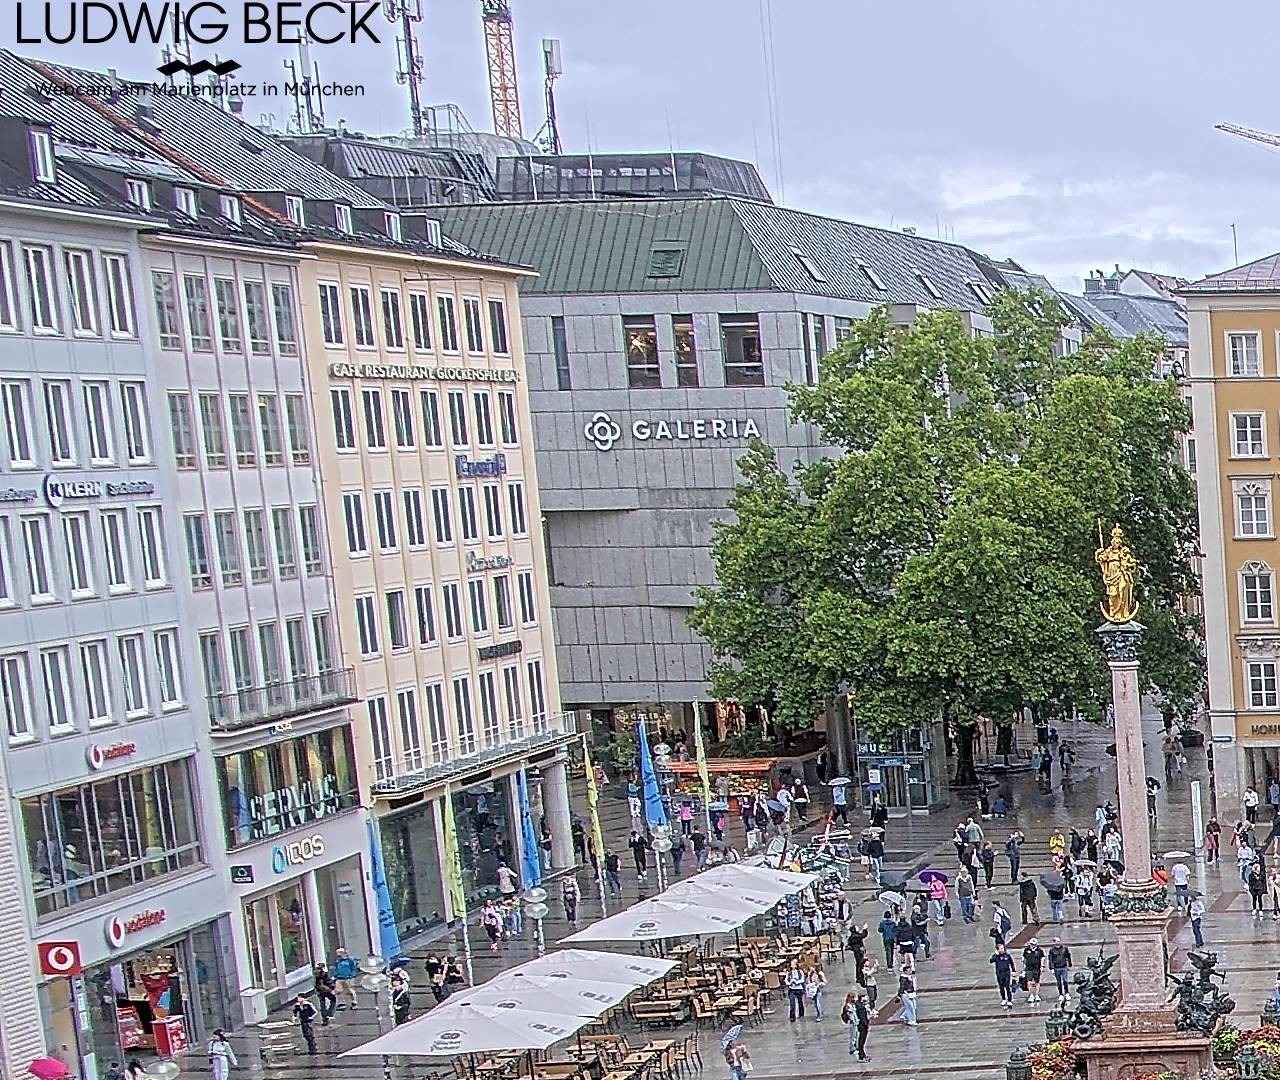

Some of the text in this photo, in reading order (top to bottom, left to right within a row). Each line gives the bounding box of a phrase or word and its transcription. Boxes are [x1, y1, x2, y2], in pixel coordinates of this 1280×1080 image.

[632, 418, 761, 440] GALERIA
[62, 481, 103, 498] KERN
[286, 834, 325, 866] IQOS
[124, 908, 166, 934] vodafone
